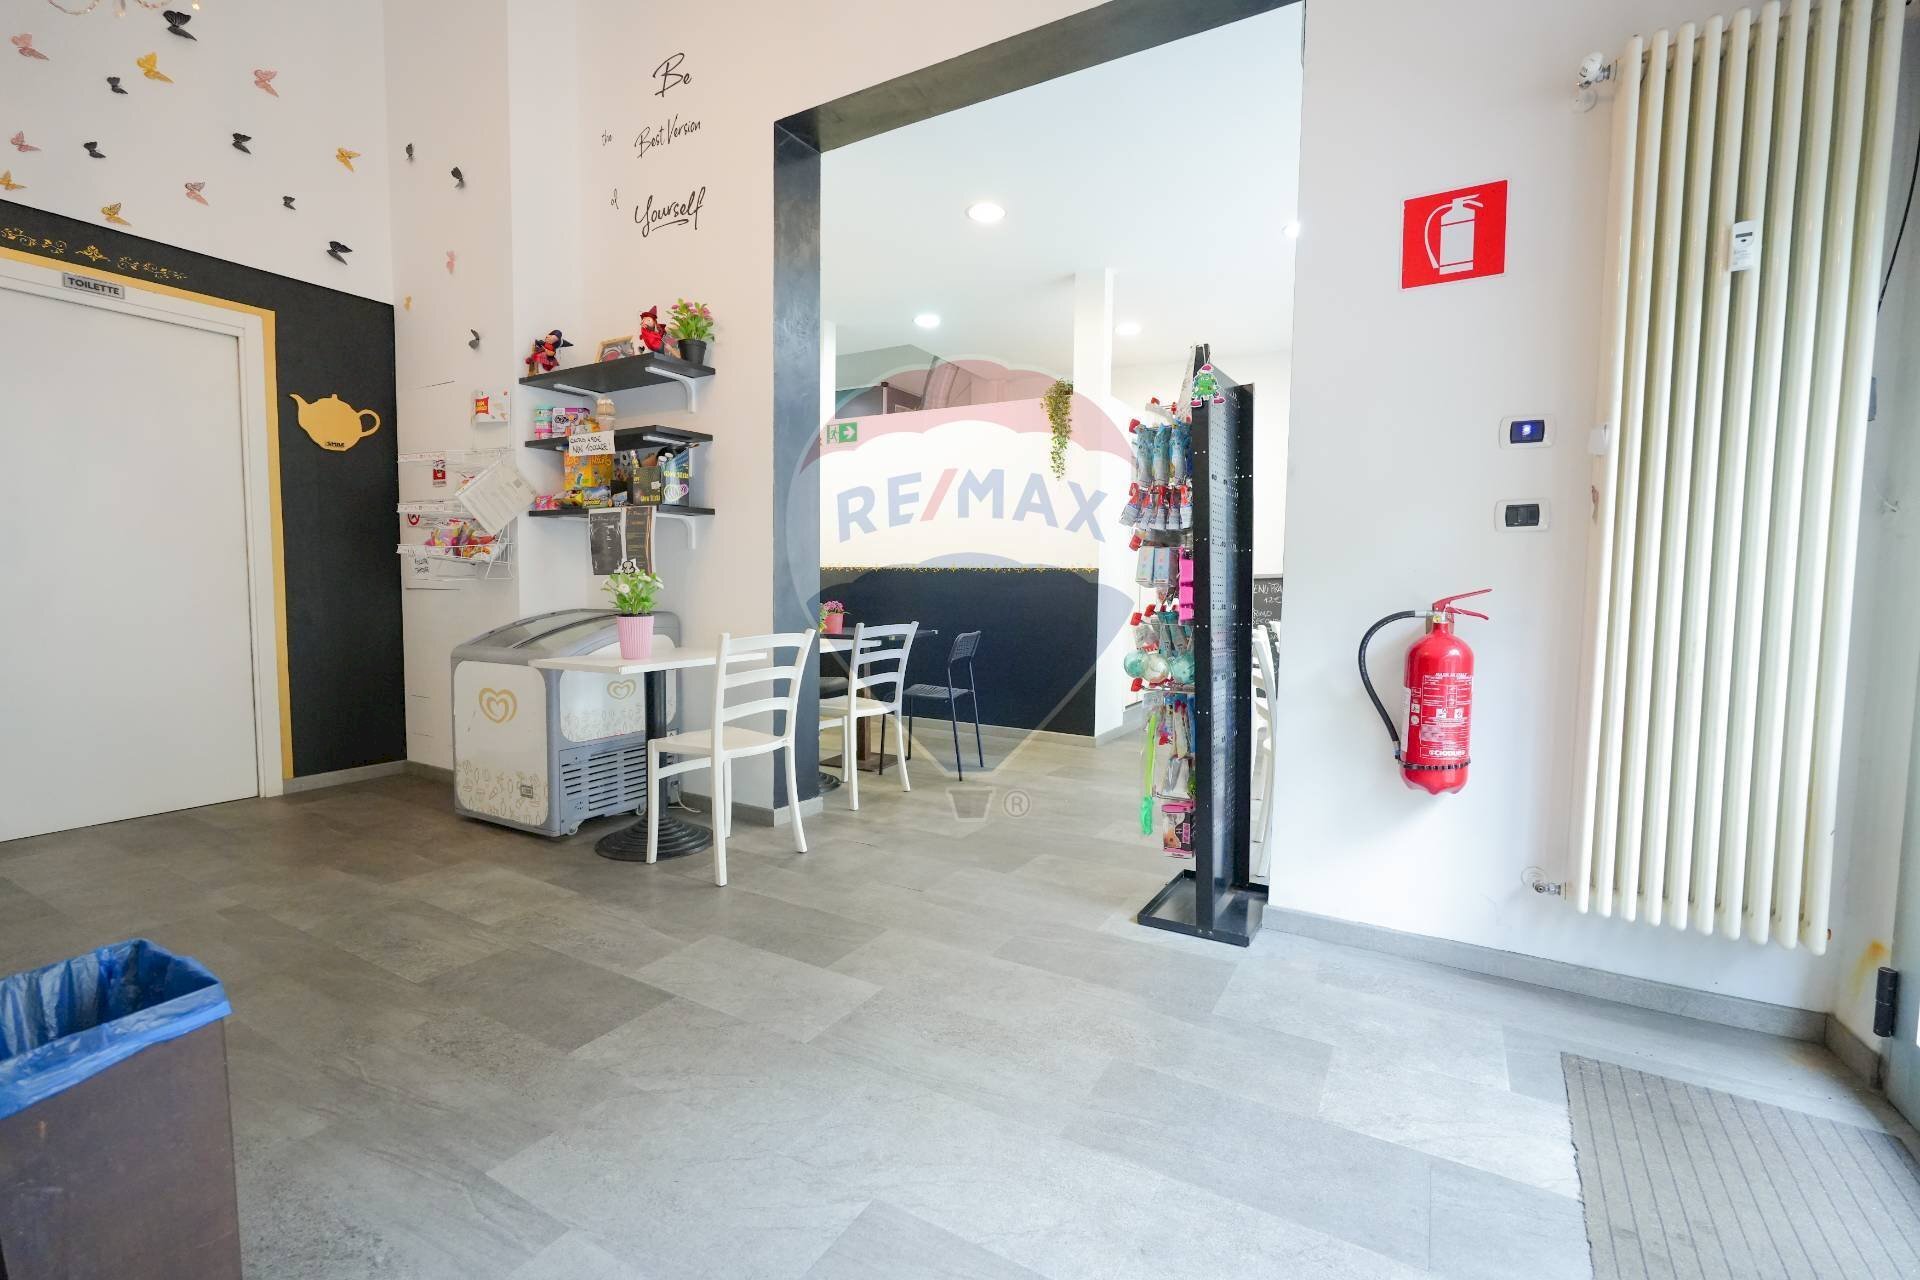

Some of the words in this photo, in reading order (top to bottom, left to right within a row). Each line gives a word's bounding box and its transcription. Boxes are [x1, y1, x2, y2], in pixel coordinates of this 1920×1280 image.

[652, 52, 692, 98] Be
[634, 126, 665, 159] Best
[667, 113, 701, 145] Version
[634, 186, 706, 238] Yourself
[68, 277, 119, 295] TOILETTE
